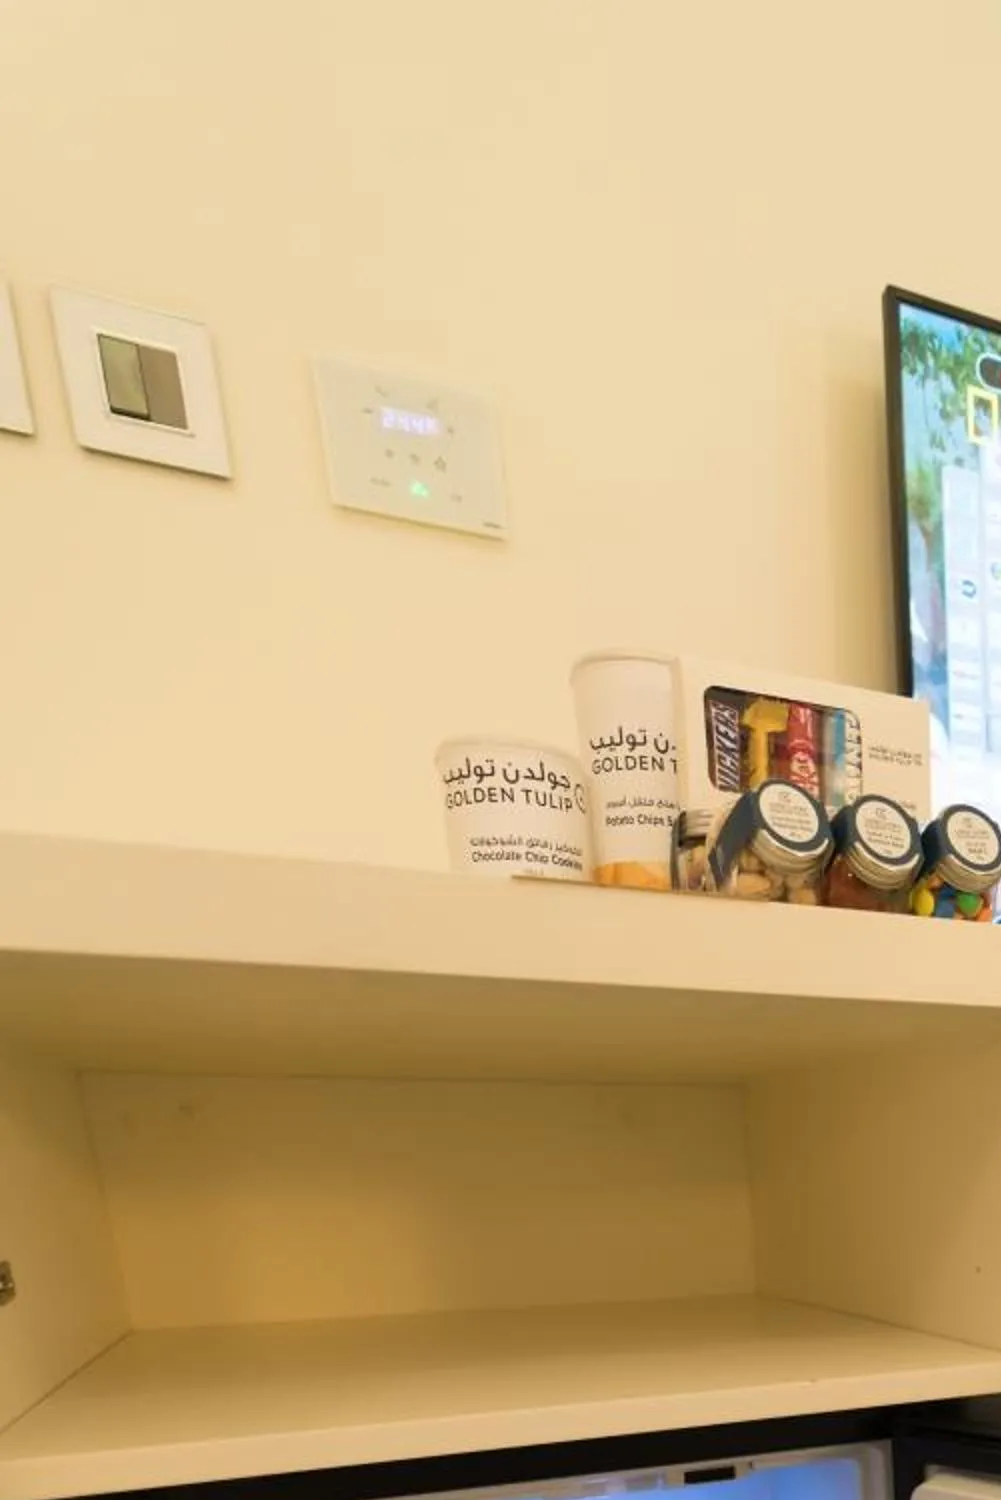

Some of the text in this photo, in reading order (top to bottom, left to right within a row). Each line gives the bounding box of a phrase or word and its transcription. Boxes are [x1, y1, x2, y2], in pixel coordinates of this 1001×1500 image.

[591, 755, 665, 775] GOLDEN
[446, 786, 574, 813] GOLDEN TULIP
[471, 850, 522, 863] Chocolate
[524, 850, 550, 865] Chip
